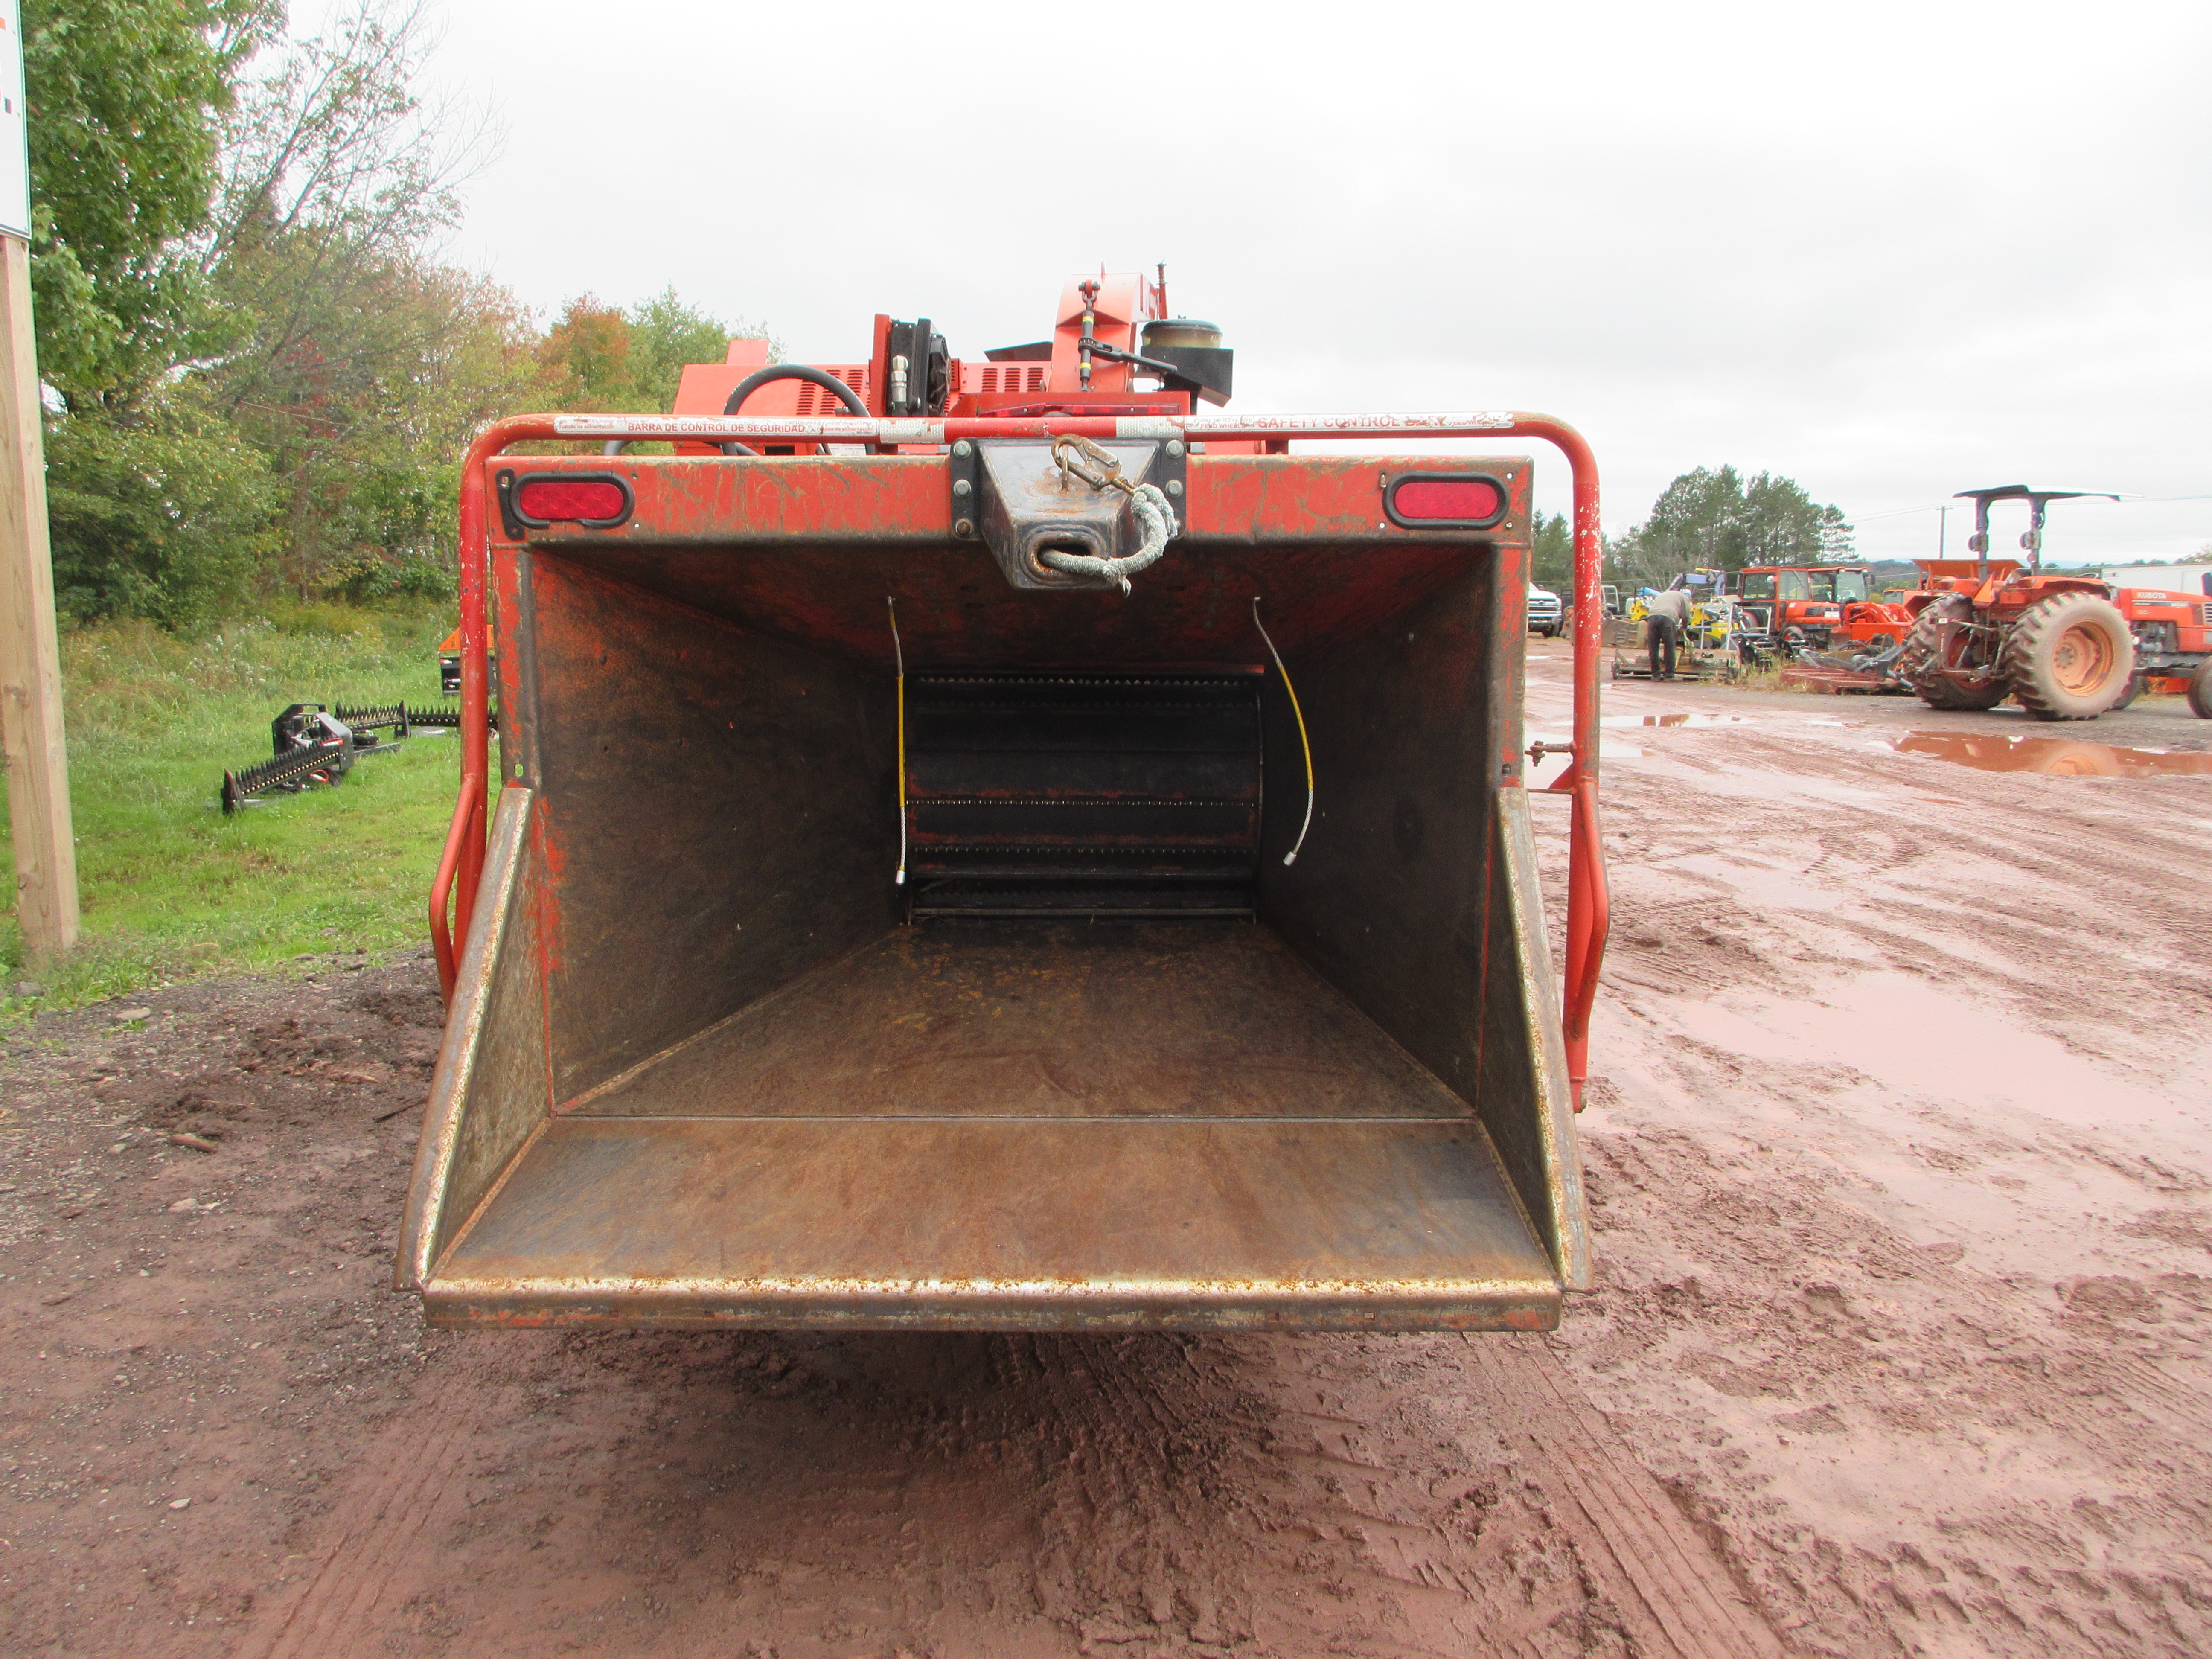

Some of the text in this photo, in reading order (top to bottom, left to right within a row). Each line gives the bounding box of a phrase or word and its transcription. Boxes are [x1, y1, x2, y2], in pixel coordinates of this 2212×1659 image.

[1258, 417, 1316, 428] SAFETY
[1324, 415, 1400, 428] CONTROL
[628, 423, 663, 431] BARRA
[681, 423, 728, 431] CONTROL
[731, 424, 744, 432] DE
[747, 424, 805, 432] SEGURIDAD
